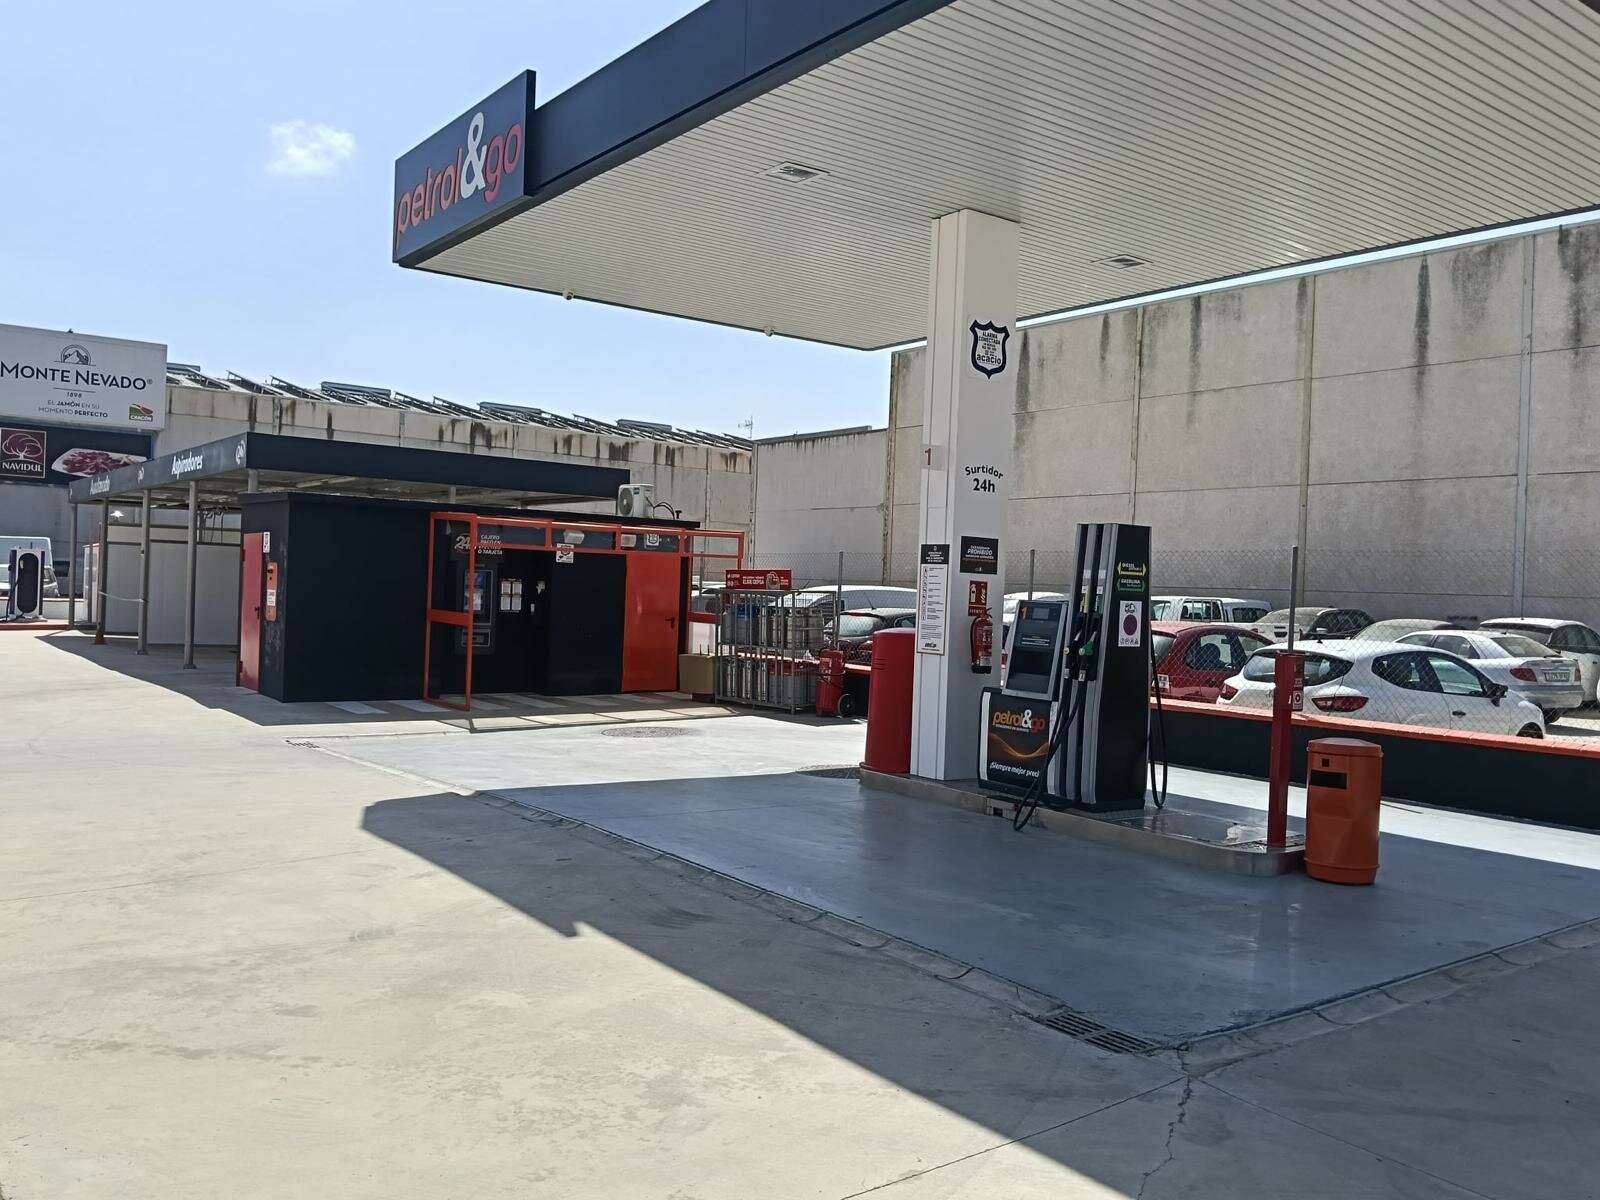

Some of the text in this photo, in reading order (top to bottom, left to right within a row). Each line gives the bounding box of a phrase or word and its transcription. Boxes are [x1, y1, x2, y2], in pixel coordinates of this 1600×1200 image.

[395, 111, 522, 248] petrol&go
[976, 354, 1002, 365] acacio
[0, 361, 70, 383] MONTE
[57, 400, 80, 408] JAMÓN
[38, 407, 108, 418] MOMENTO PERFECTO
[2, 461, 43, 472] NAVIDUL
[171, 452, 203, 480] Aspiradores
[964, 465, 1004, 479] Surtidor
[973, 478, 995, 493] 24h
[1021, 607, 1029, 619] 1
[992, 709, 1046, 734] petrol&go
[1011, 766, 1026, 776] mejor
